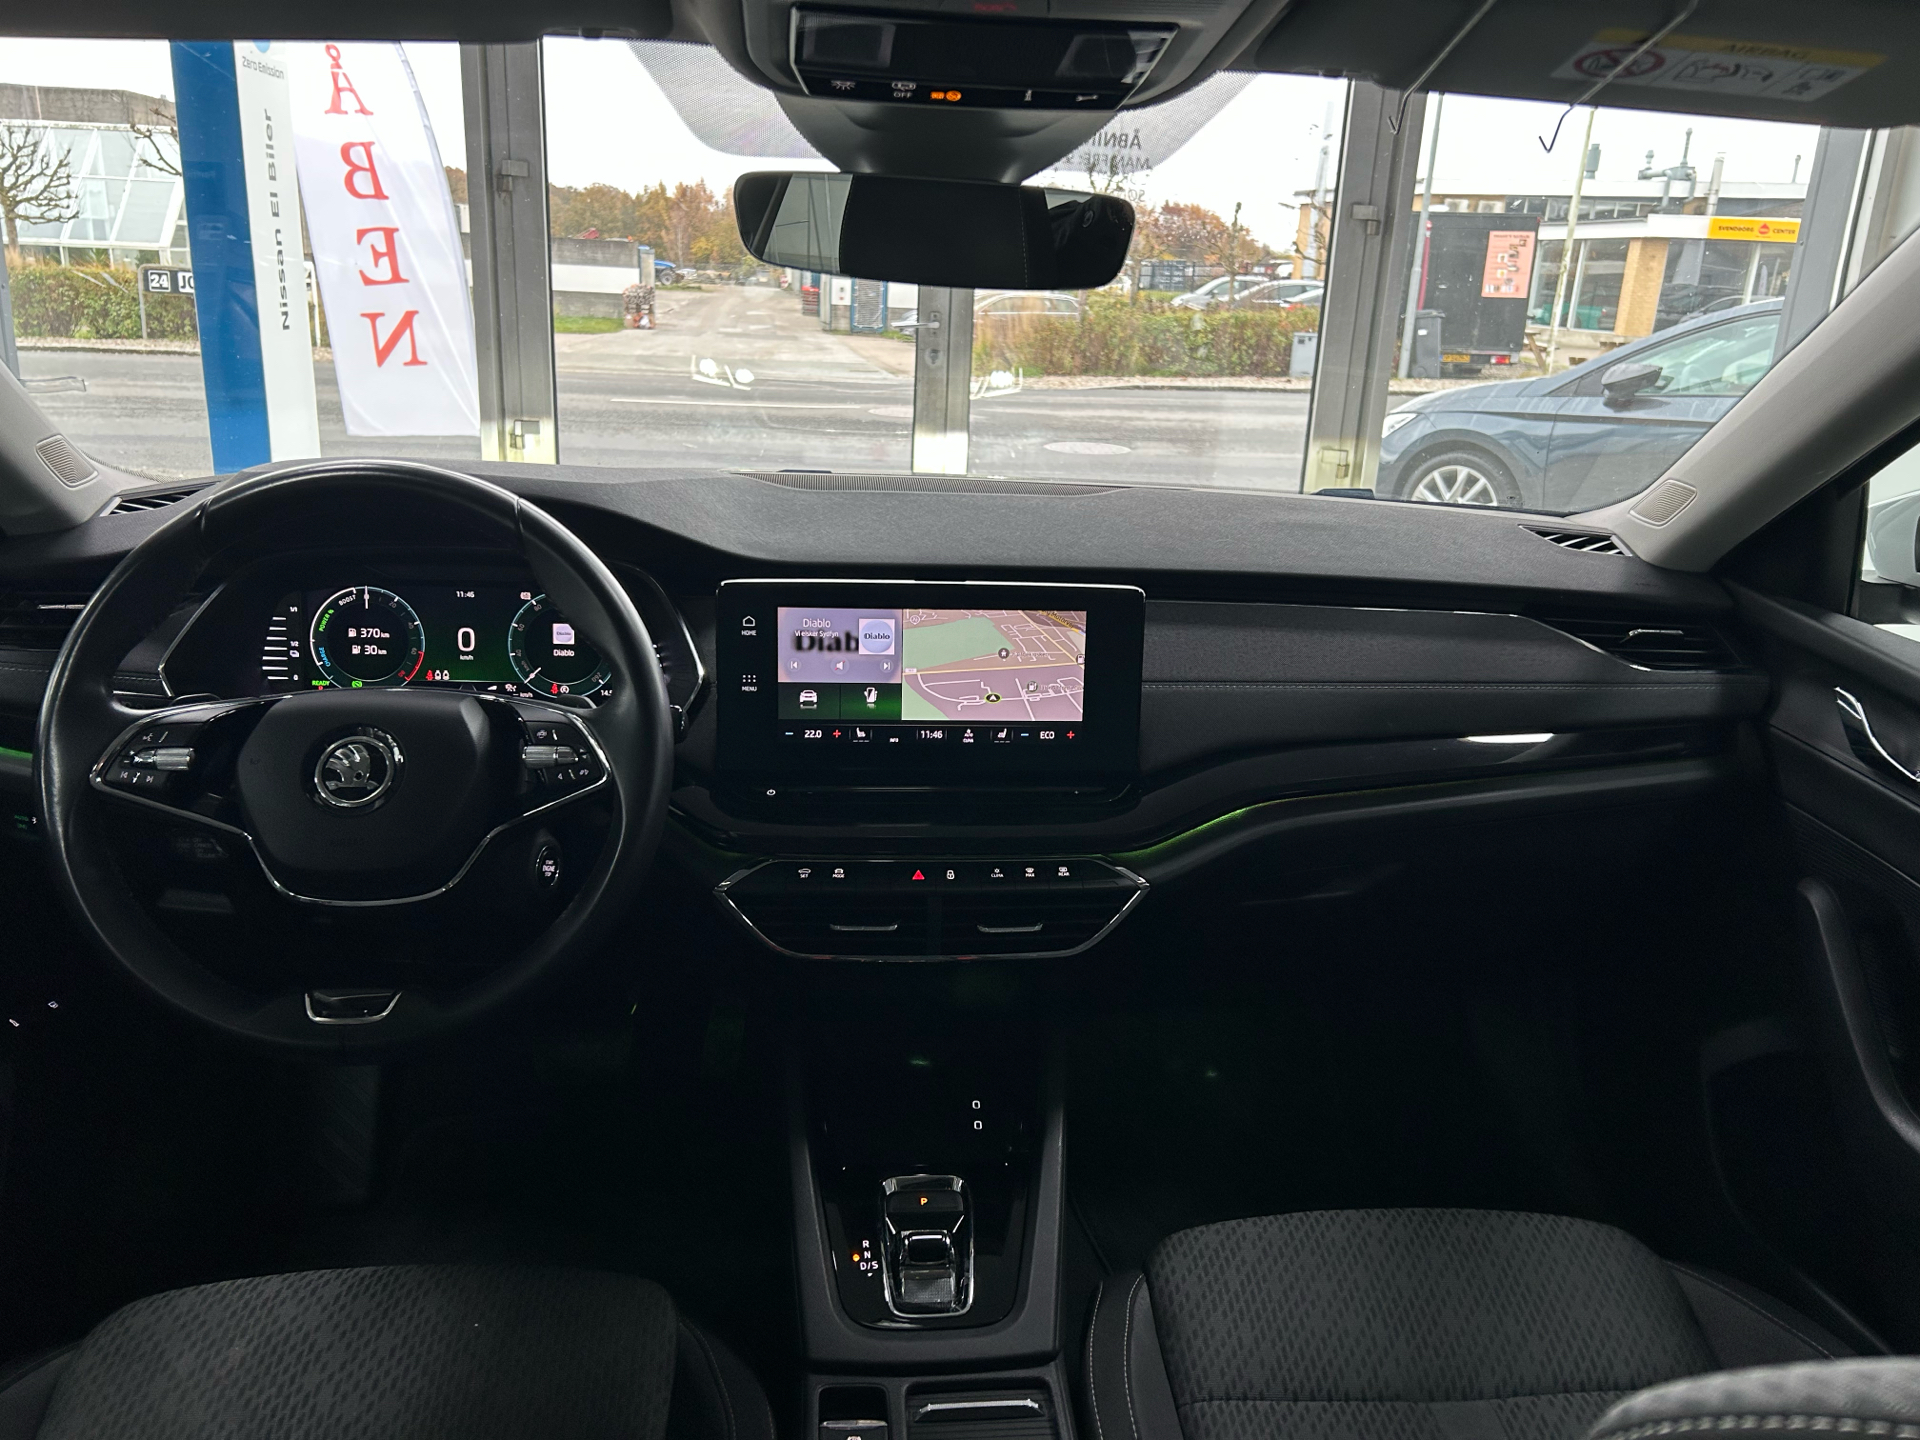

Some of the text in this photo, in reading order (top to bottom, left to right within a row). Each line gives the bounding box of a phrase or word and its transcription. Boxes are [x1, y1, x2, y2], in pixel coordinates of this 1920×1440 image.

[242, 55, 285, 80] Zero Emission
[264, 108, 291, 331] Nissan El Biler
[150, 273, 169, 288] 24
[338, 594, 356, 606] BOOST
[802, 618, 831, 628] Diablo
[360, 628, 381, 638] 370
[863, 632, 891, 640] Diablo
[457, 627, 475, 652] 0
[364, 645, 378, 655] 30
[553, 649, 575, 657] Diablo
[804, 730, 822, 738] 22.0
[920, 730, 943, 739] 11:46
[1040, 731, 1055, 739] ECO
[862, 1240, 870, 1248] R
[863, 1250, 871, 1259] N
[860, 1260, 879, 1270] D/S
